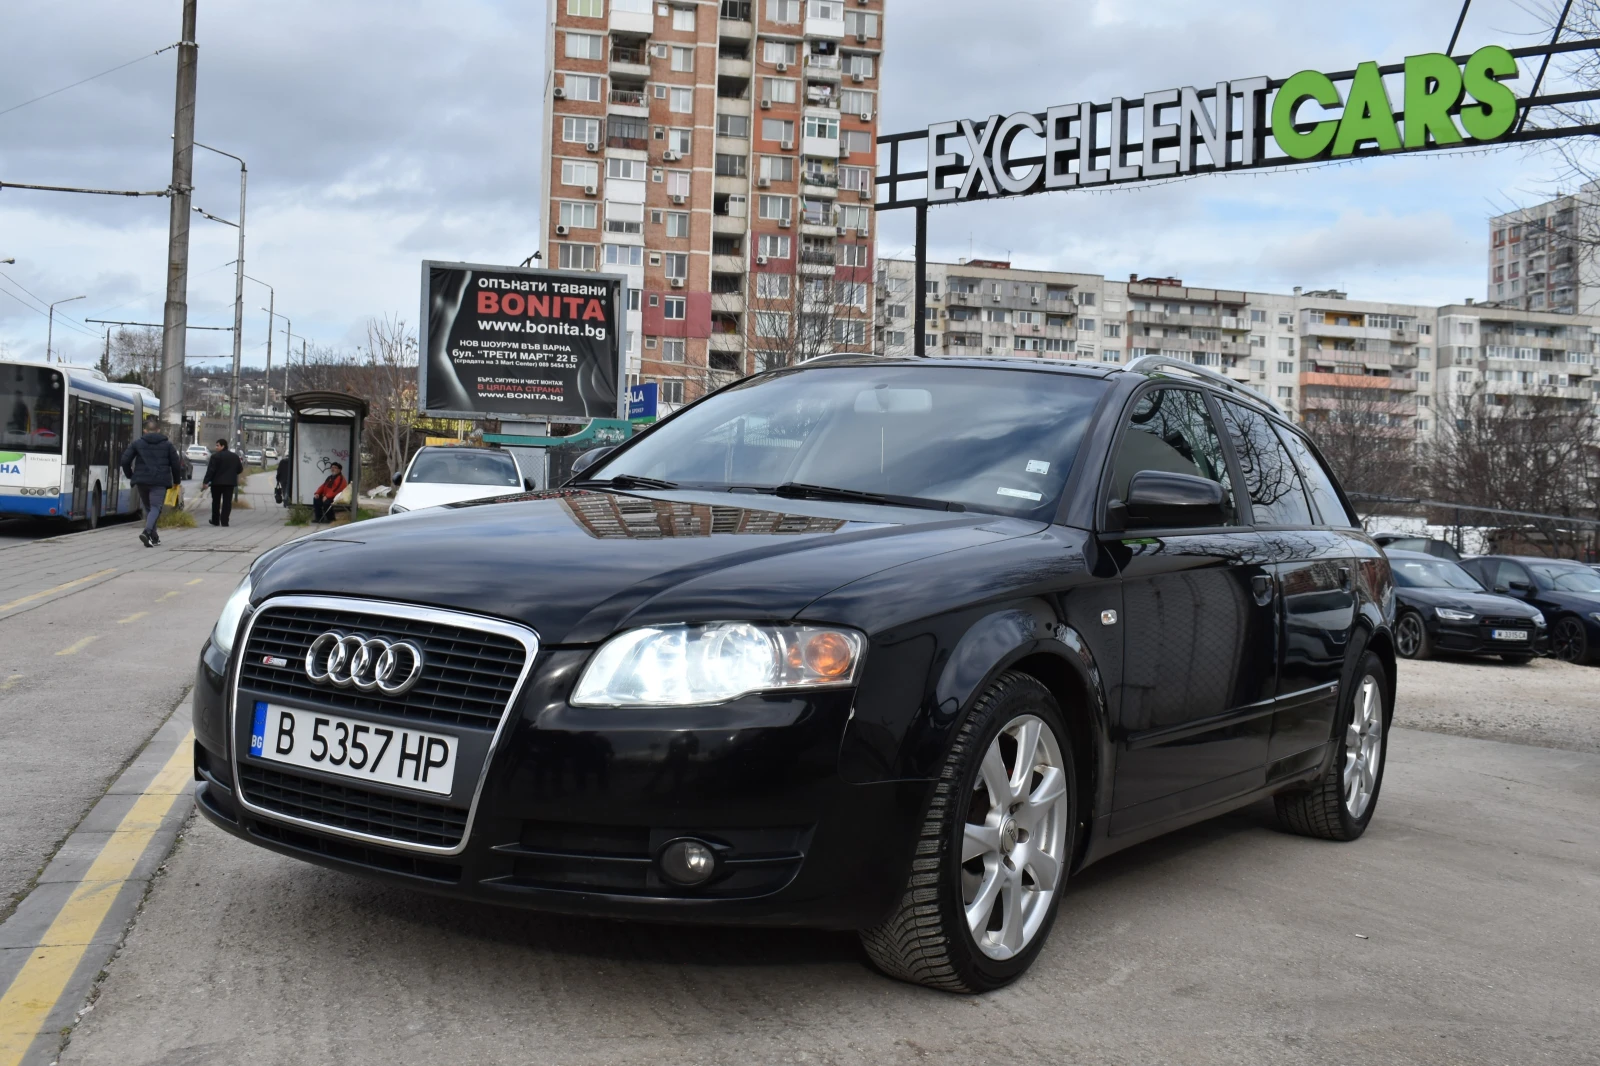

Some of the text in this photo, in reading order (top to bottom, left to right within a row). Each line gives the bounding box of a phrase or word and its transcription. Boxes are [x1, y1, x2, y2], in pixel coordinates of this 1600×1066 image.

[927, 45, 1519, 202] EXCELLENT CARS
[478, 278, 606, 296] опънати тавани
[477, 291, 606, 321] BONITA
[478, 320, 606, 341] www.bonita.bg
[481, 341, 518, 349] ШОУРУМ
[542, 344, 571, 352] ВАРНА
[452, 349, 474, 358] бул.
[556, 354, 568, 362] 22
[570, 355, 578, 363] Б
[478, 392, 564, 401] www.BONITA.bg
[251, 735, 263, 749] BG
[276, 711, 449, 782] B 5357 HP
